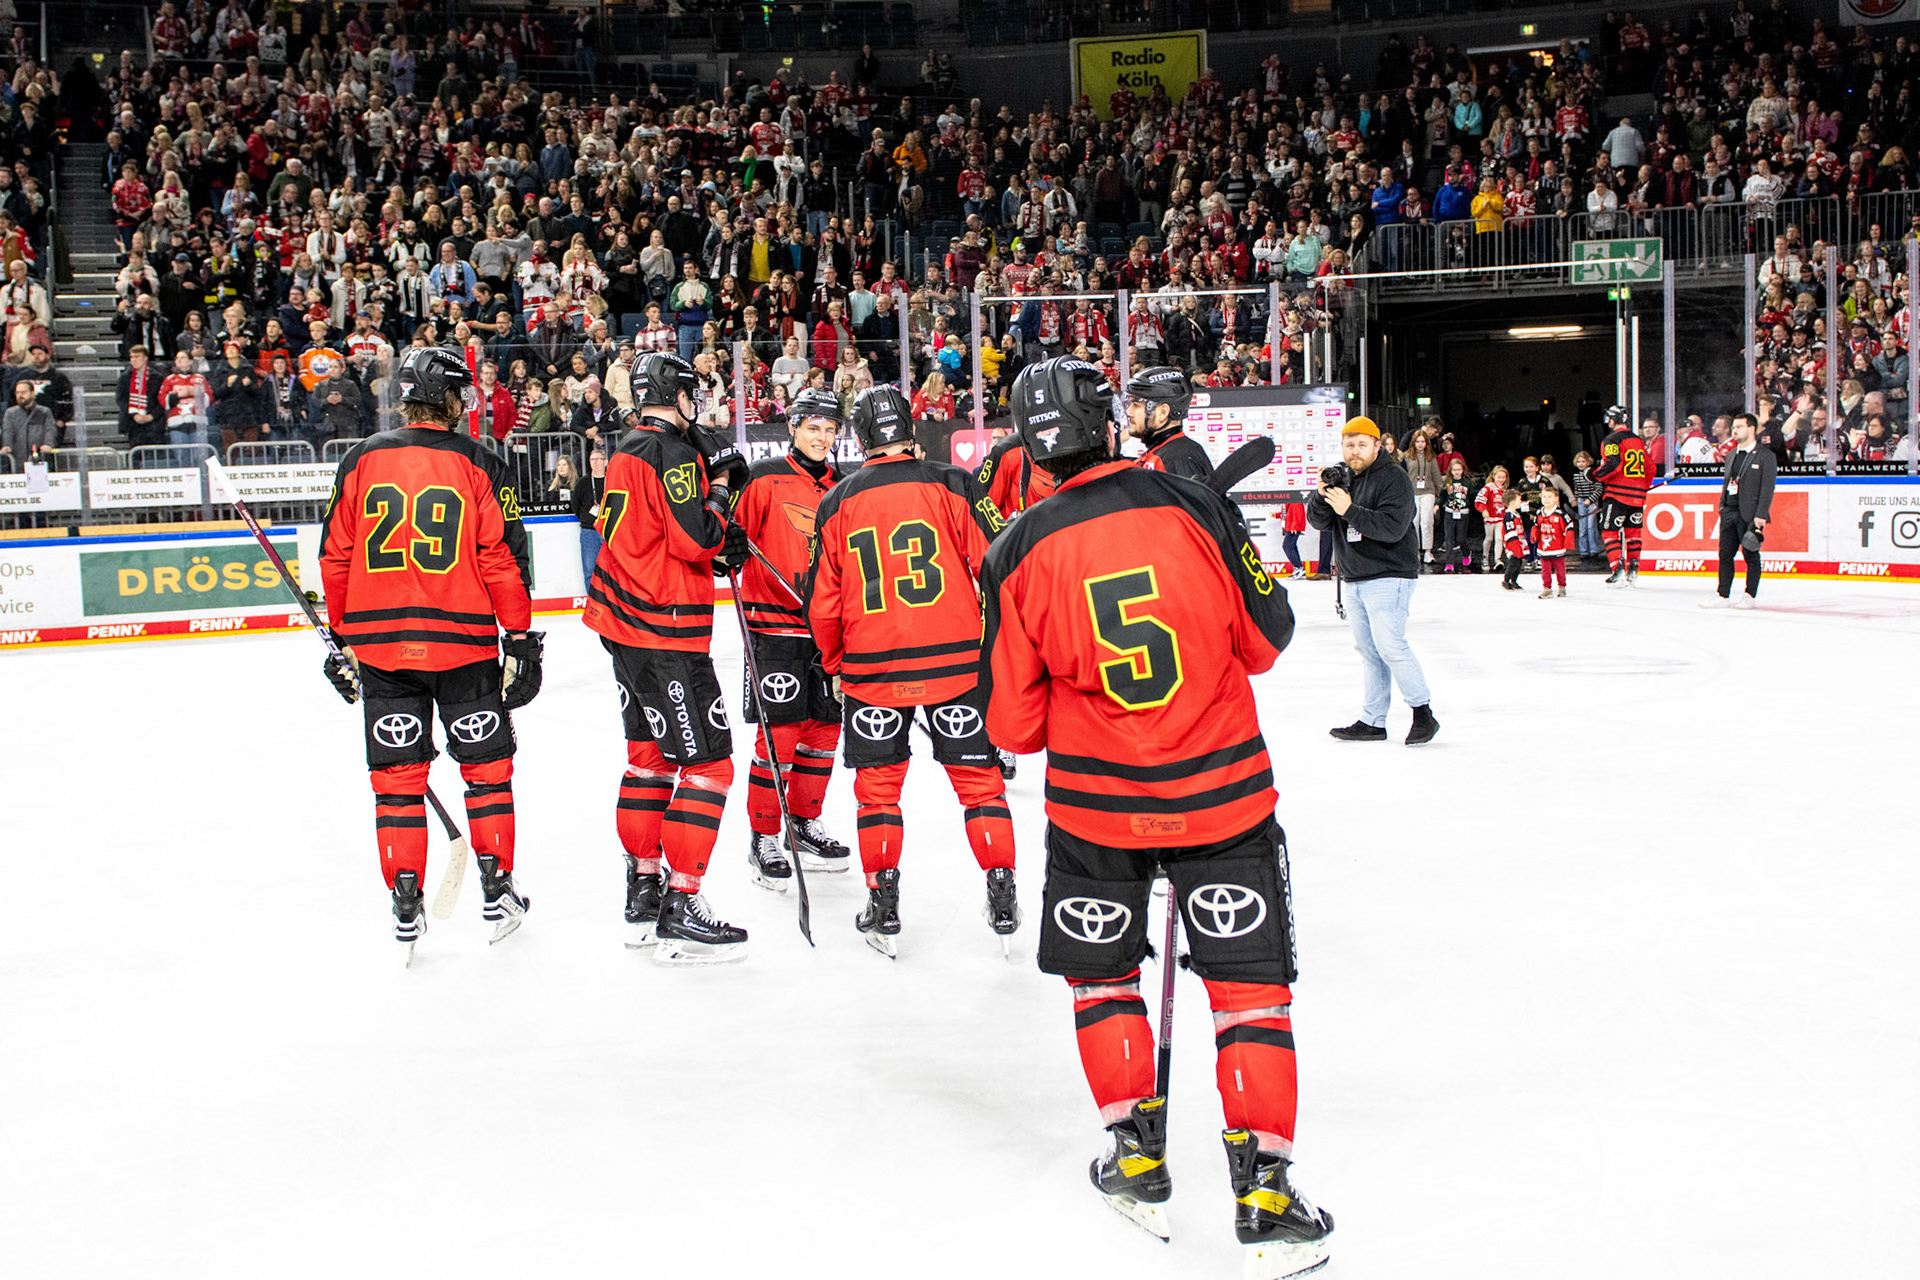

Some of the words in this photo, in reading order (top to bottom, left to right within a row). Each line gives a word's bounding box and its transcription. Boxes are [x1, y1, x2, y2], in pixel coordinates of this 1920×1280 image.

[1111, 48, 1166, 67] Radio
[1117, 71, 1160, 88] Köln
[1149, 371, 1185, 384] STETSON
[879, 401, 890, 412] 13
[1034, 389, 1045, 405] 5
[876, 414, 899, 424] STETSON
[1604, 443, 1620, 457] 26
[1623, 448, 1646, 478] 26
[663, 462, 697, 505] 67
[1858, 497, 1887, 506] FOLGE
[1889, 496, 1908, 505] UNS
[364, 482, 466, 575] 29
[597, 489, 630, 551] 7
[0, 562, 35, 580] Ops
[846, 518, 946, 616] 13
[1240, 541, 1274, 596] 5
[1083, 564, 1184, 712] 5
[675, 702, 698, 758] TOYOTA
[961, 753, 988, 761] BAUER
[501, 896, 522, 915] CCM
